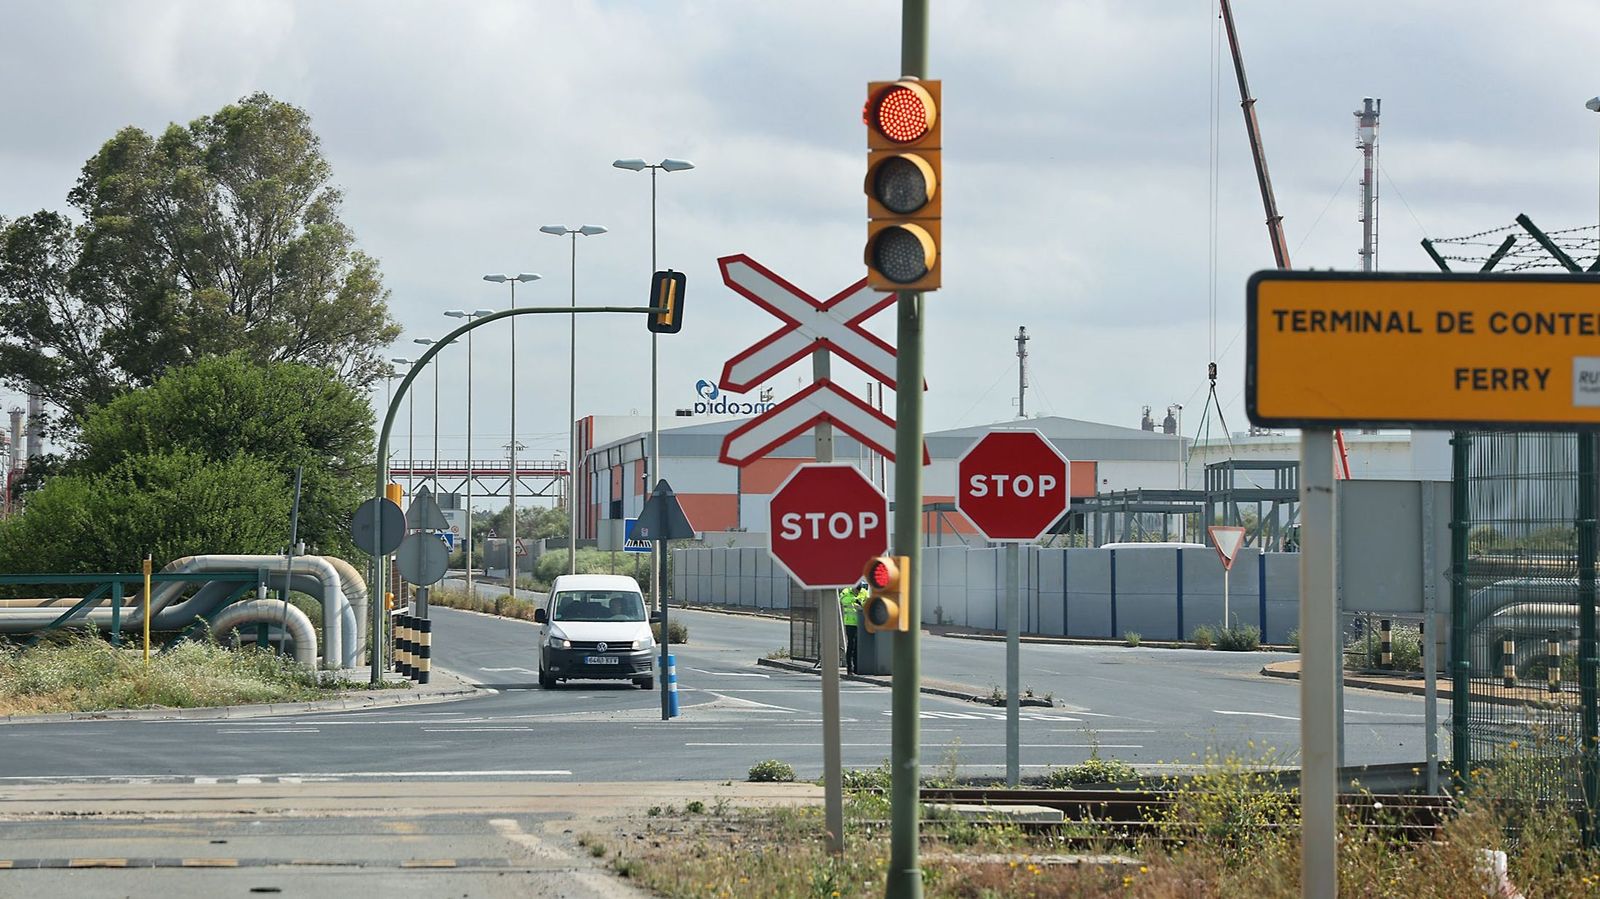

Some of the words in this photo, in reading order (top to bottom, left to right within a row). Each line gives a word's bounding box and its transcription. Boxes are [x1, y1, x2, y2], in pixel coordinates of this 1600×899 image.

[1272, 309, 1422, 333] TERMINAL
[1436, 311, 1475, 334] DE
[1488, 312, 1600, 336] CONTE
[1454, 367, 1552, 391] FERRY
[1579, 370, 1600, 385] RU
[968, 474, 1057, 498] STOP
[779, 511, 879, 541] STOP
